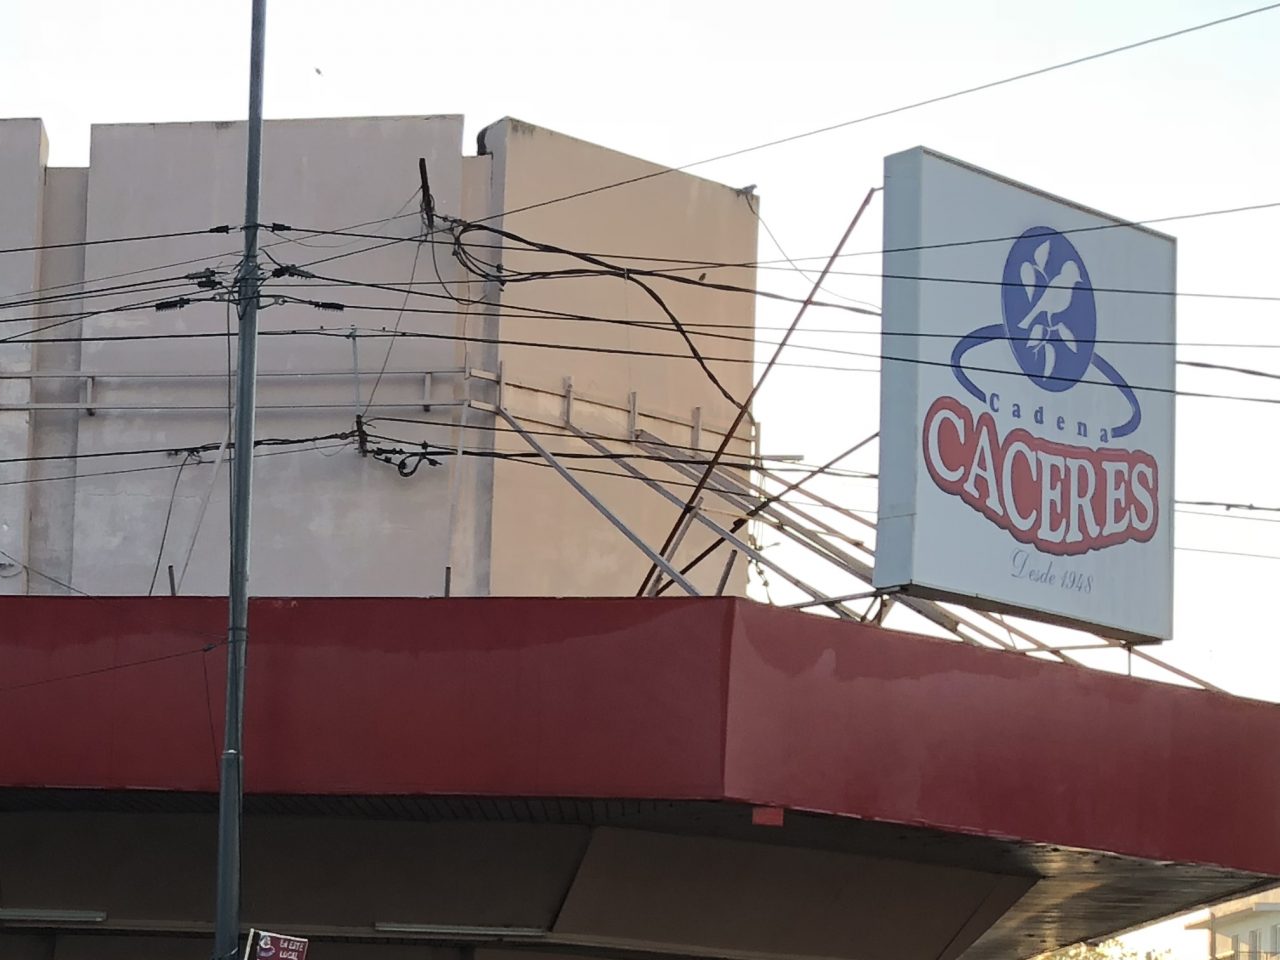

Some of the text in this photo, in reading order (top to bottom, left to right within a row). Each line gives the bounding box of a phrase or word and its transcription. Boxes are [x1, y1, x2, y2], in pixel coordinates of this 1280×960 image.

[989, 392, 1110, 443] Cadena
[926, 408, 1155, 544] CACERES
[1011, 547, 1094, 594] Desde 1948
